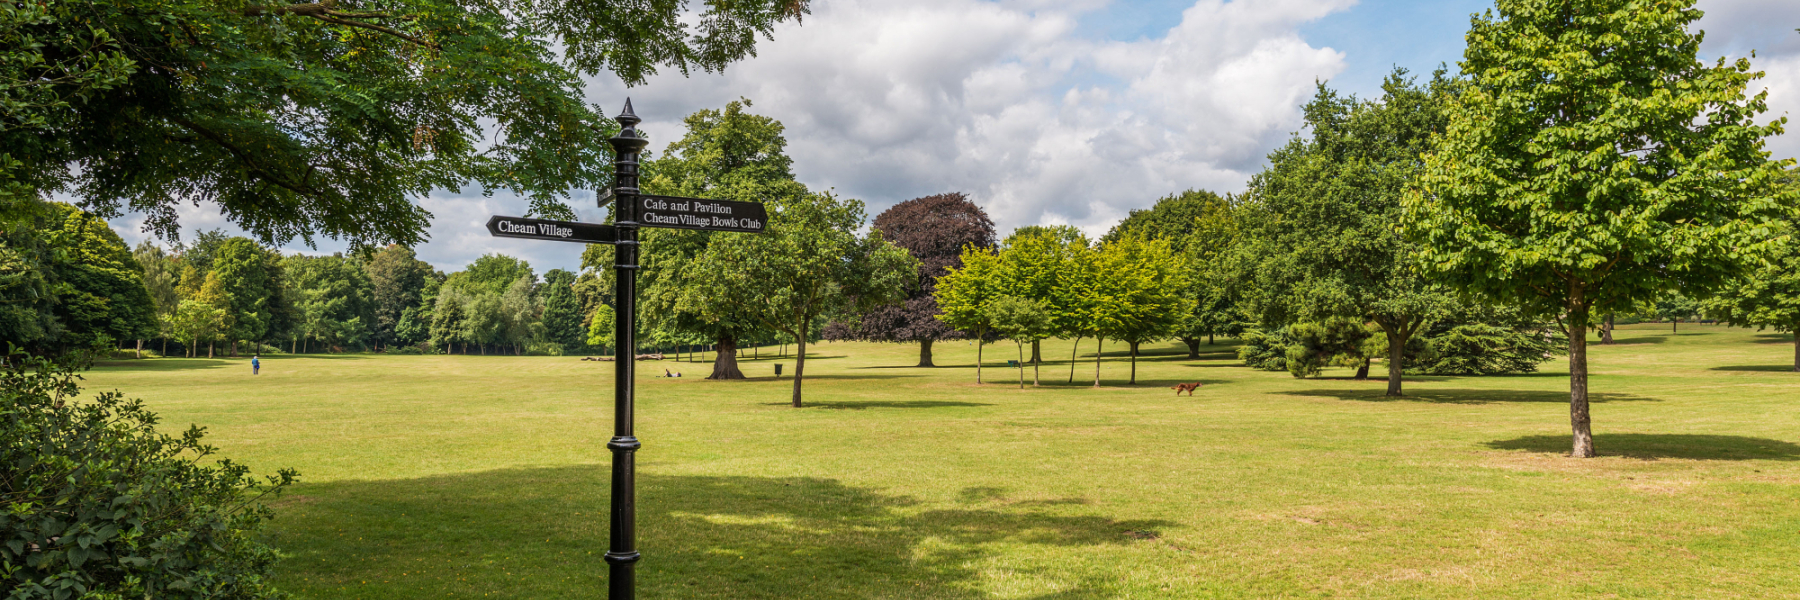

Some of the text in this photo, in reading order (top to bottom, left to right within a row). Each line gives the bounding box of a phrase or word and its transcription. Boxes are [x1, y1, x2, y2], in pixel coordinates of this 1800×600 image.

[643, 198, 732, 214] Cafe and Pavilion
[498, 220, 573, 237] Cheam Village
[643, 212, 762, 229] Cheam Village Bowls Club
